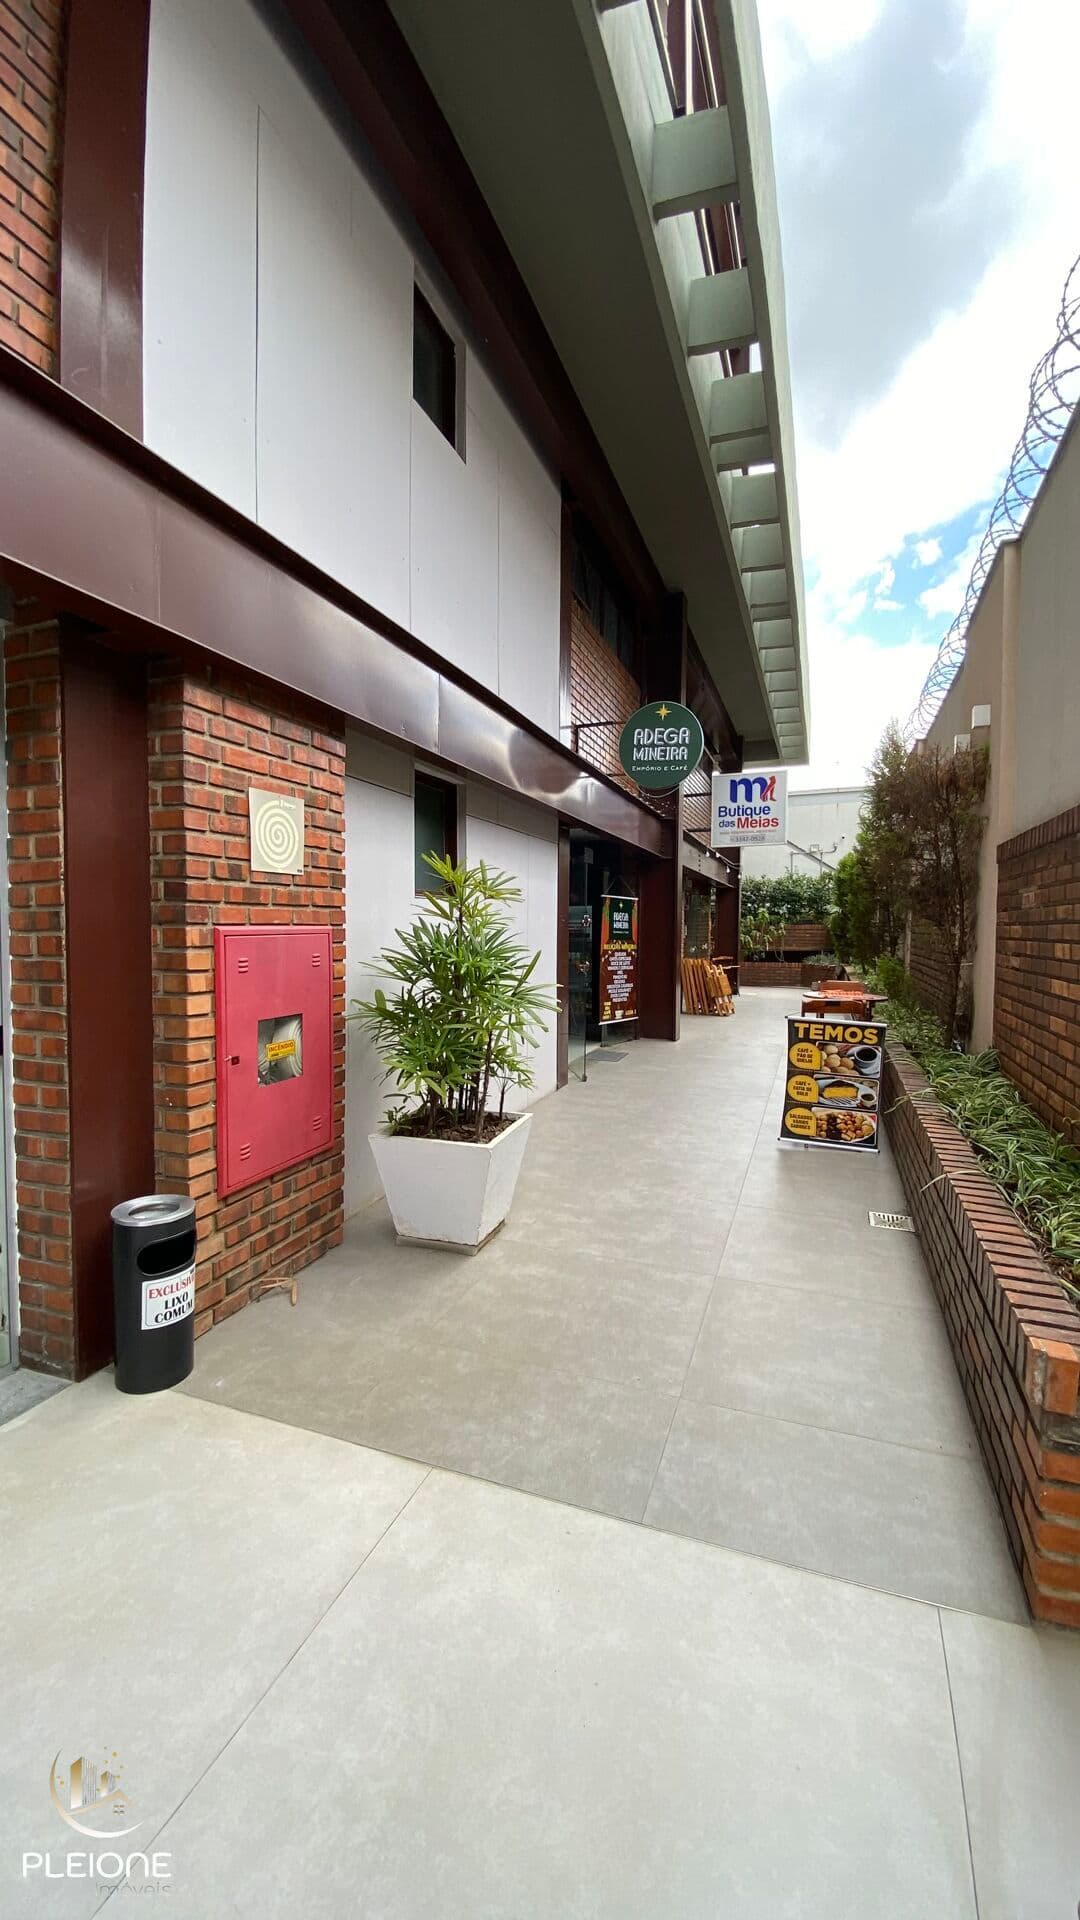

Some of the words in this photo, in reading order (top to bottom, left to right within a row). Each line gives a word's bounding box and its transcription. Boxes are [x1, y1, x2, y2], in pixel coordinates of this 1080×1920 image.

[633, 728, 690, 745] ADEGA
[633, 746, 688, 761] MINEIRA
[718, 805, 771, 818] Butique
[718, 819, 735, 828] das
[736, 816, 779, 829] Meias
[794, 1022, 879, 1045] TEMOS
[269, 1042, 293, 1052] INCÊNDIO
[164, 1291, 189, 1309] LIXO
[155, 1299, 193, 1323] COMUM
